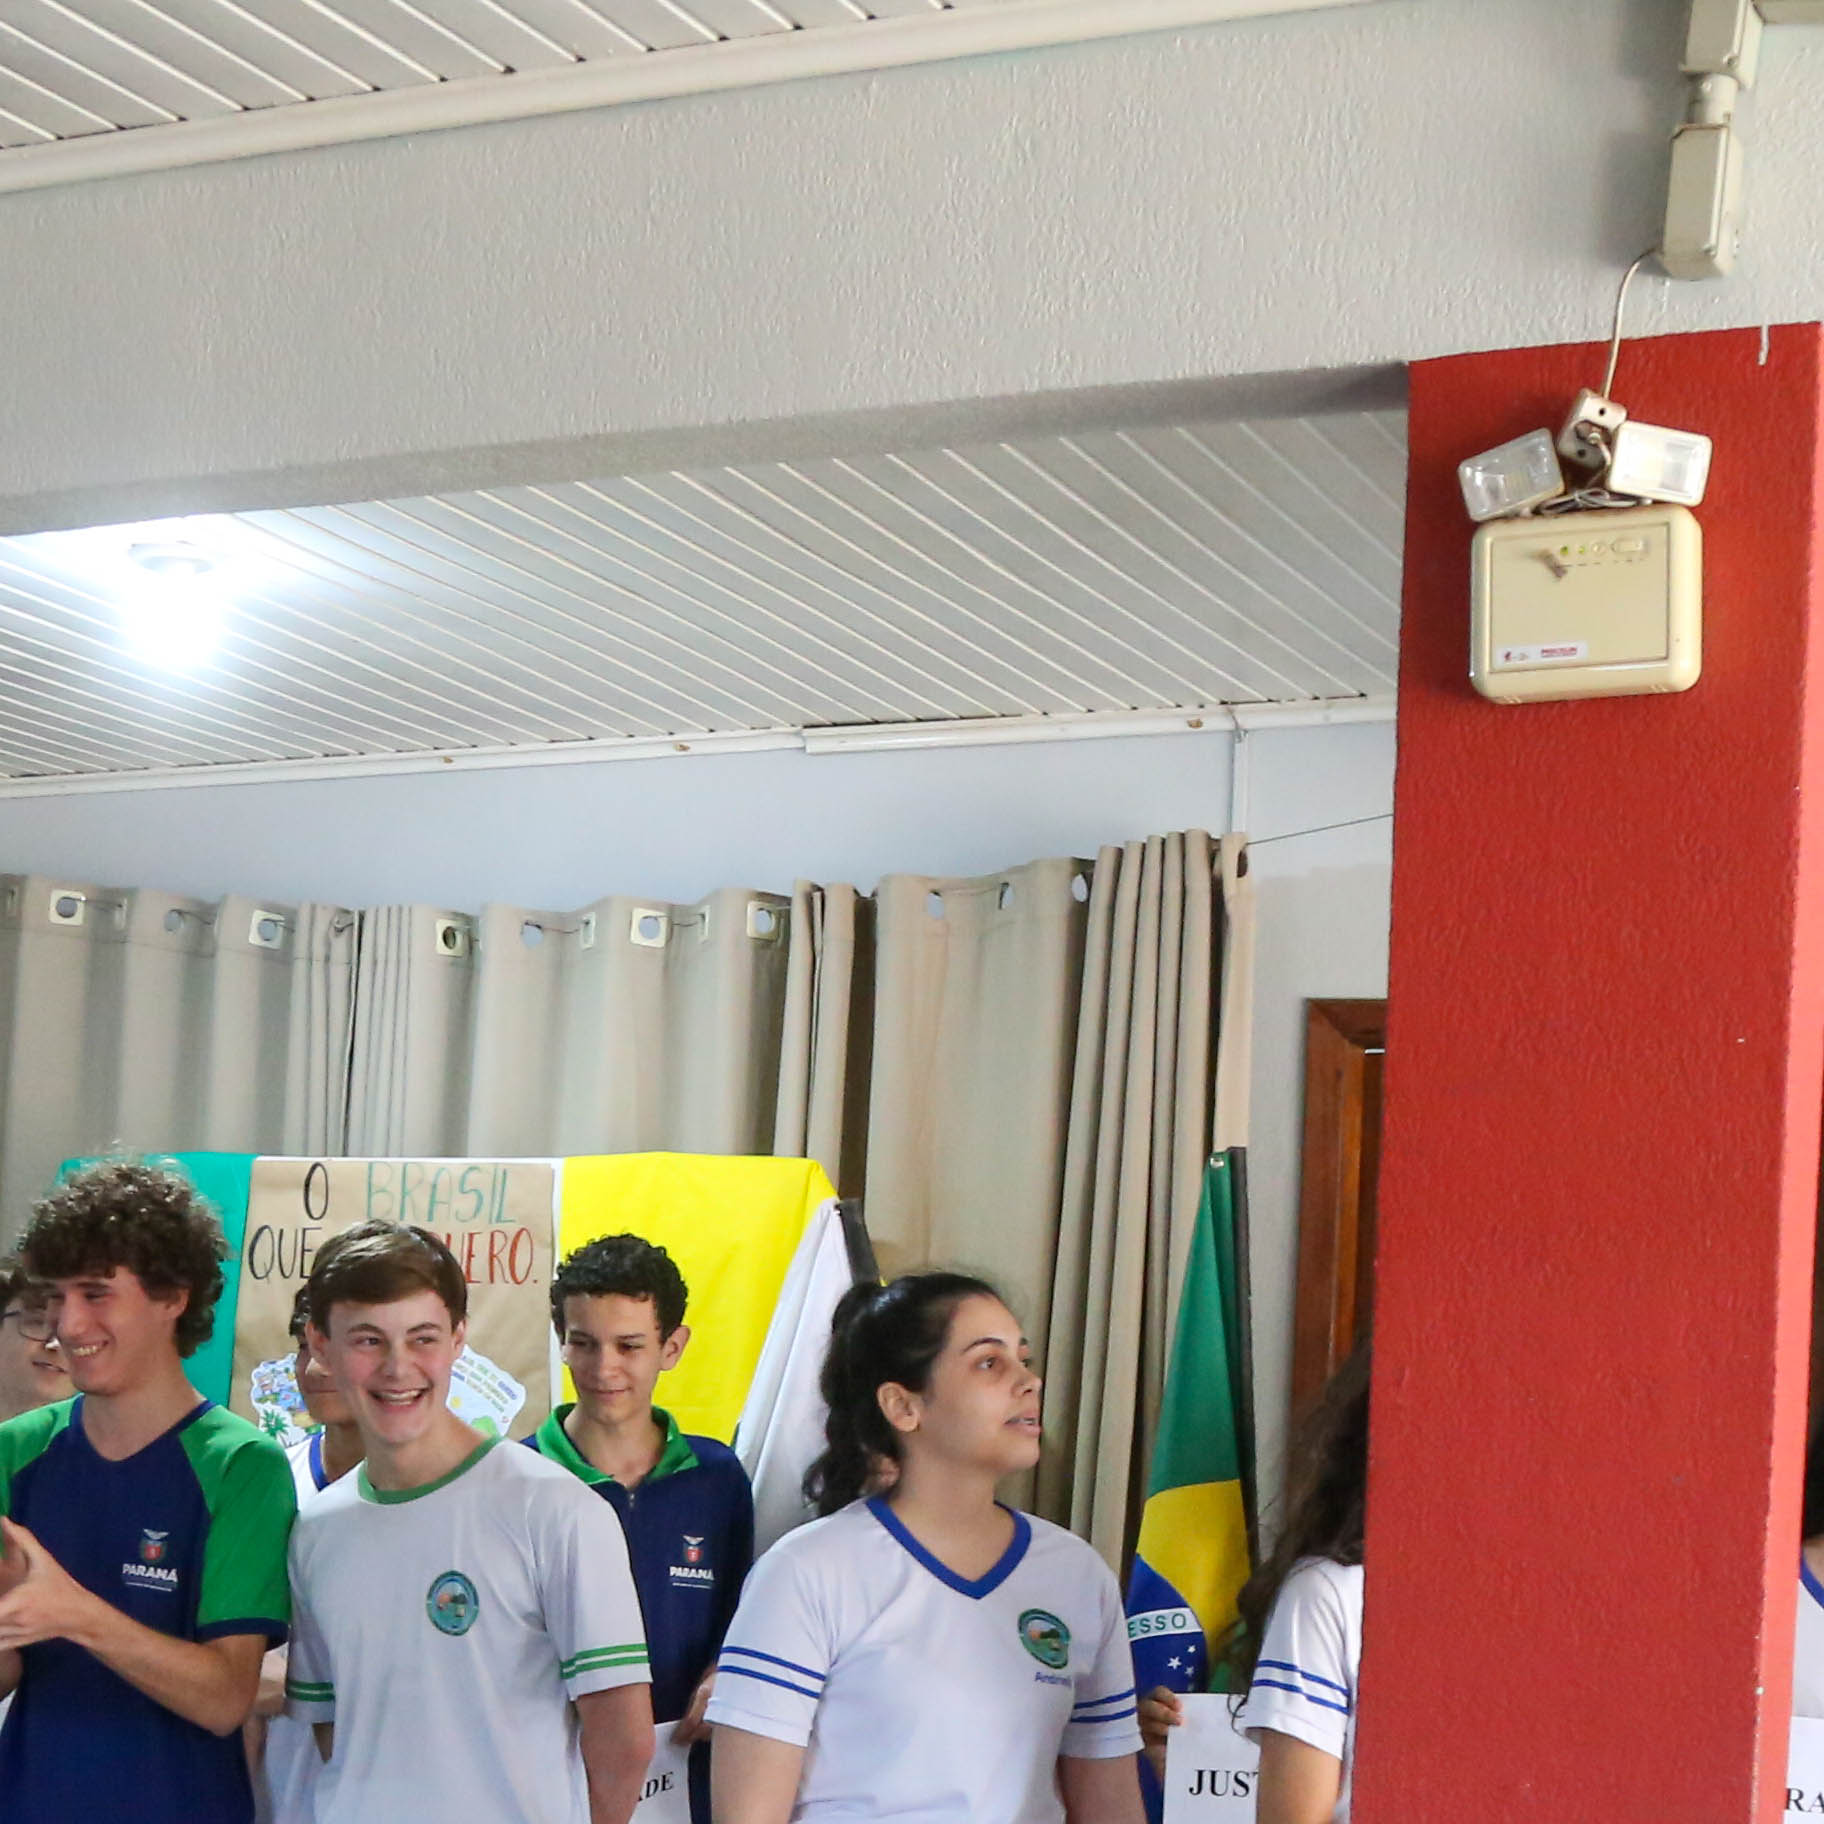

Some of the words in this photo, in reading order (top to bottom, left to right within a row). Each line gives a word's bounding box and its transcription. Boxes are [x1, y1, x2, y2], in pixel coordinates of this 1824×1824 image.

[303, 1161, 329, 1221] O
[366, 1160, 516, 1225] BRASIL
[248, 1223, 323, 1283] QUE
[430, 1226, 538, 1285] UERO.
[1127, 1612, 1187, 1639] ESSO
[638, 1770, 675, 1802] DE
[1188, 1768, 1259, 1797] JUS
